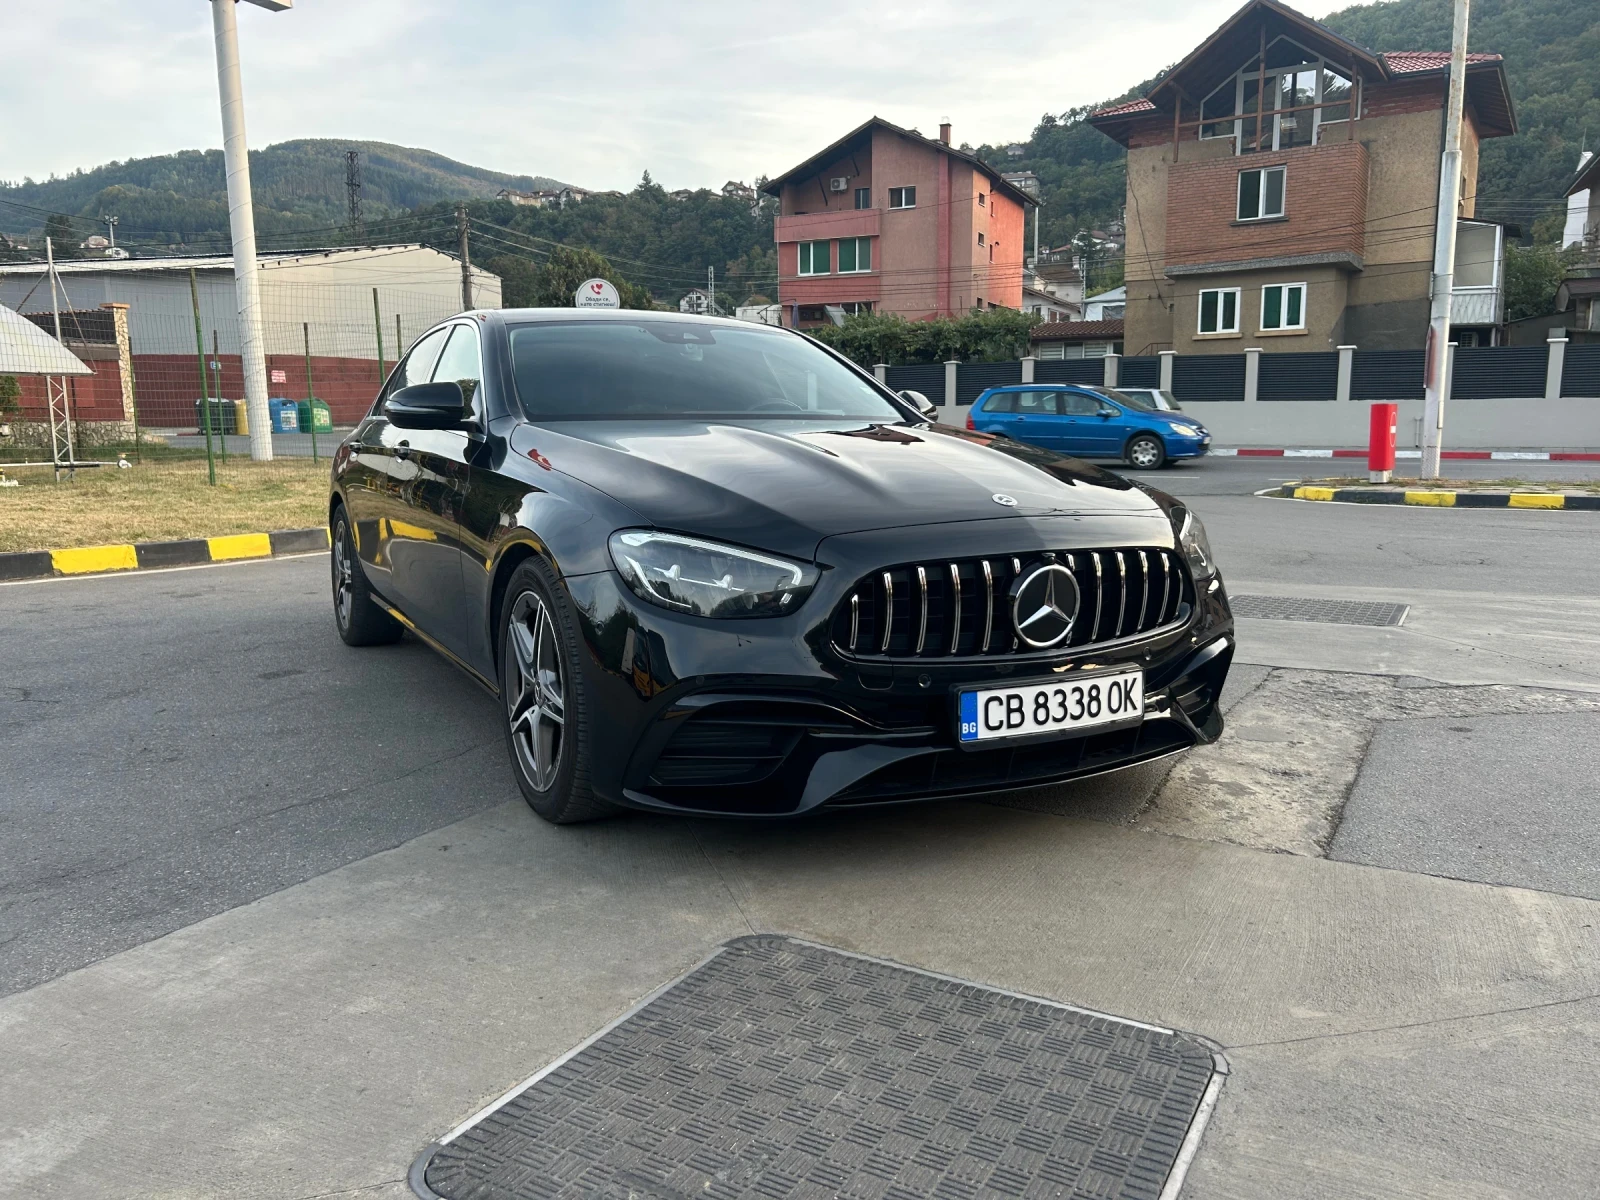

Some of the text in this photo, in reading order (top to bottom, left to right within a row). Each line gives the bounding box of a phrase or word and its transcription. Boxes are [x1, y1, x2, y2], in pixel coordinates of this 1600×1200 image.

[984, 677, 1138, 731] CB 8338 OK
[962, 722, 977, 734] BG
